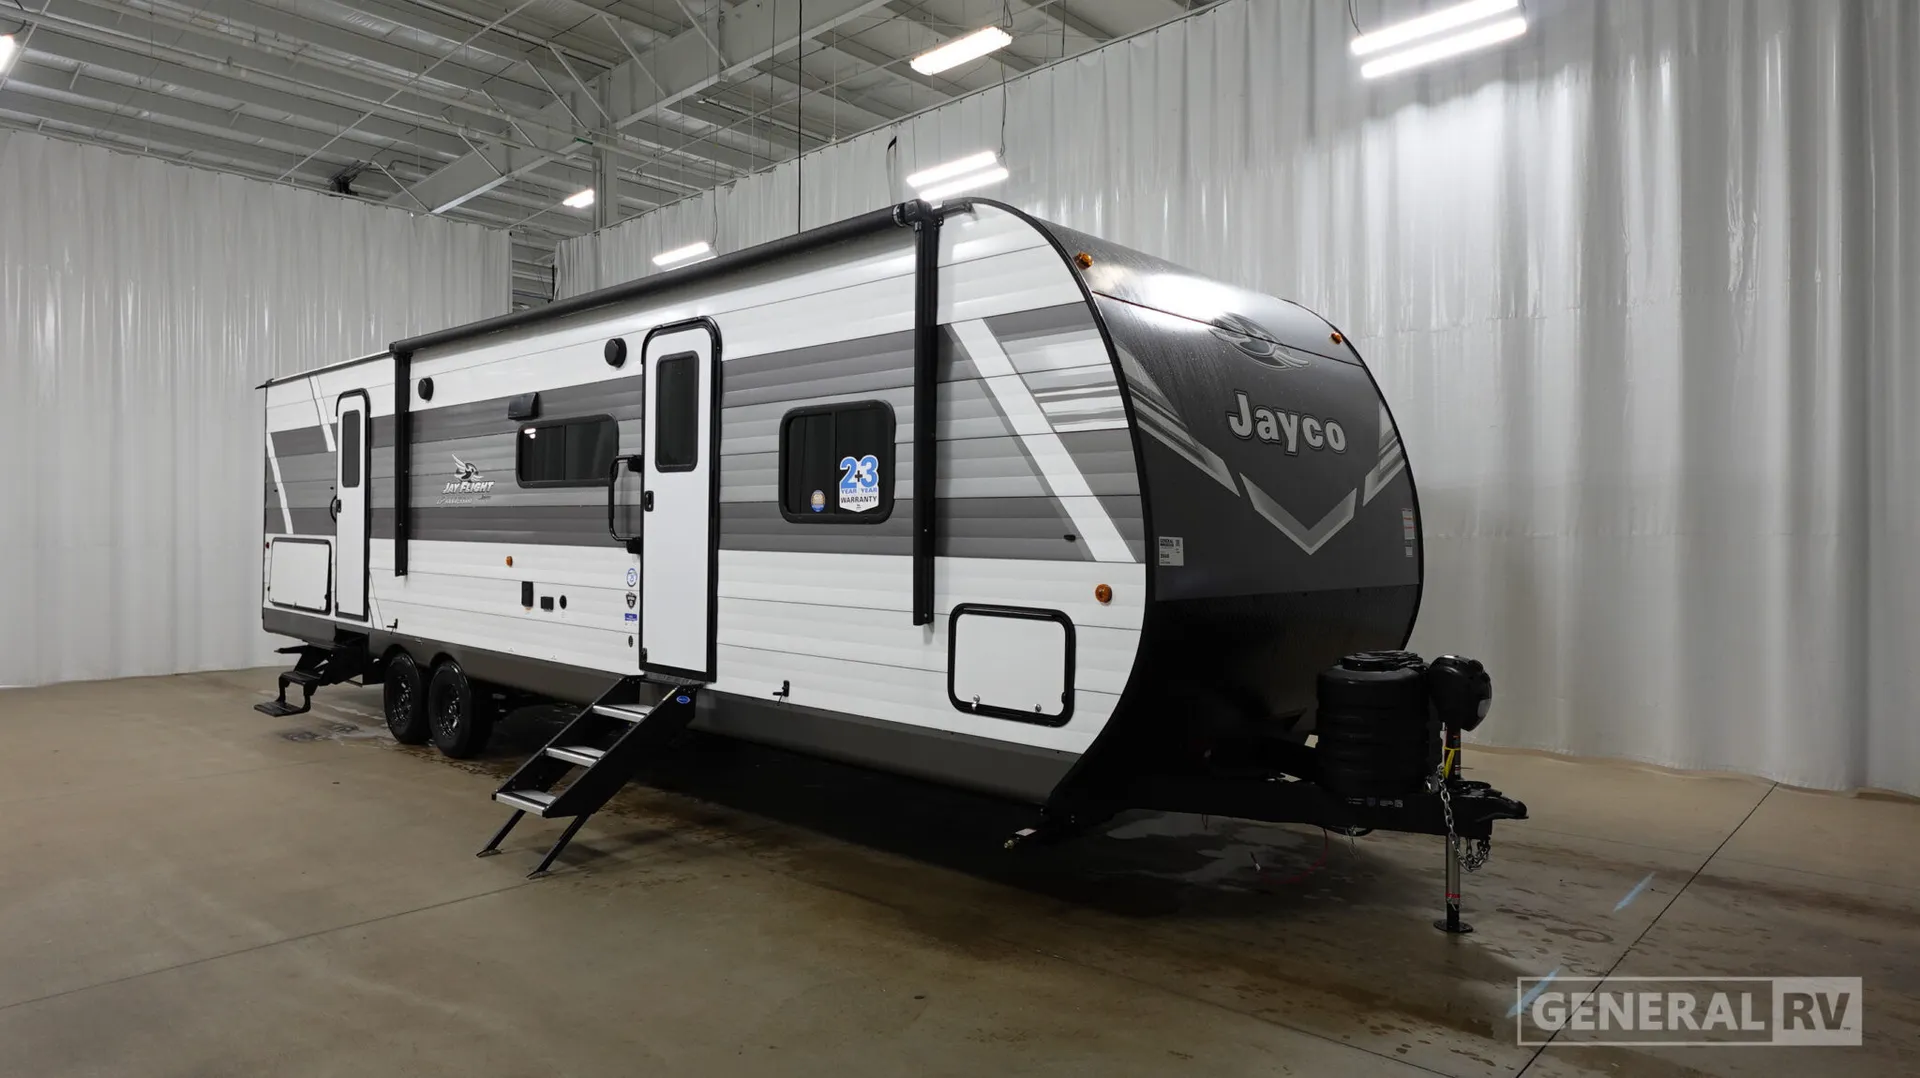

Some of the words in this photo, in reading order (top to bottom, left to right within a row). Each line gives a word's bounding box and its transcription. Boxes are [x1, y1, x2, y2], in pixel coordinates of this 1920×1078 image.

[1227, 391, 1346, 455] Jayco
[442, 482, 460, 494] JAY
[460, 481, 495, 493] FLIGHT
